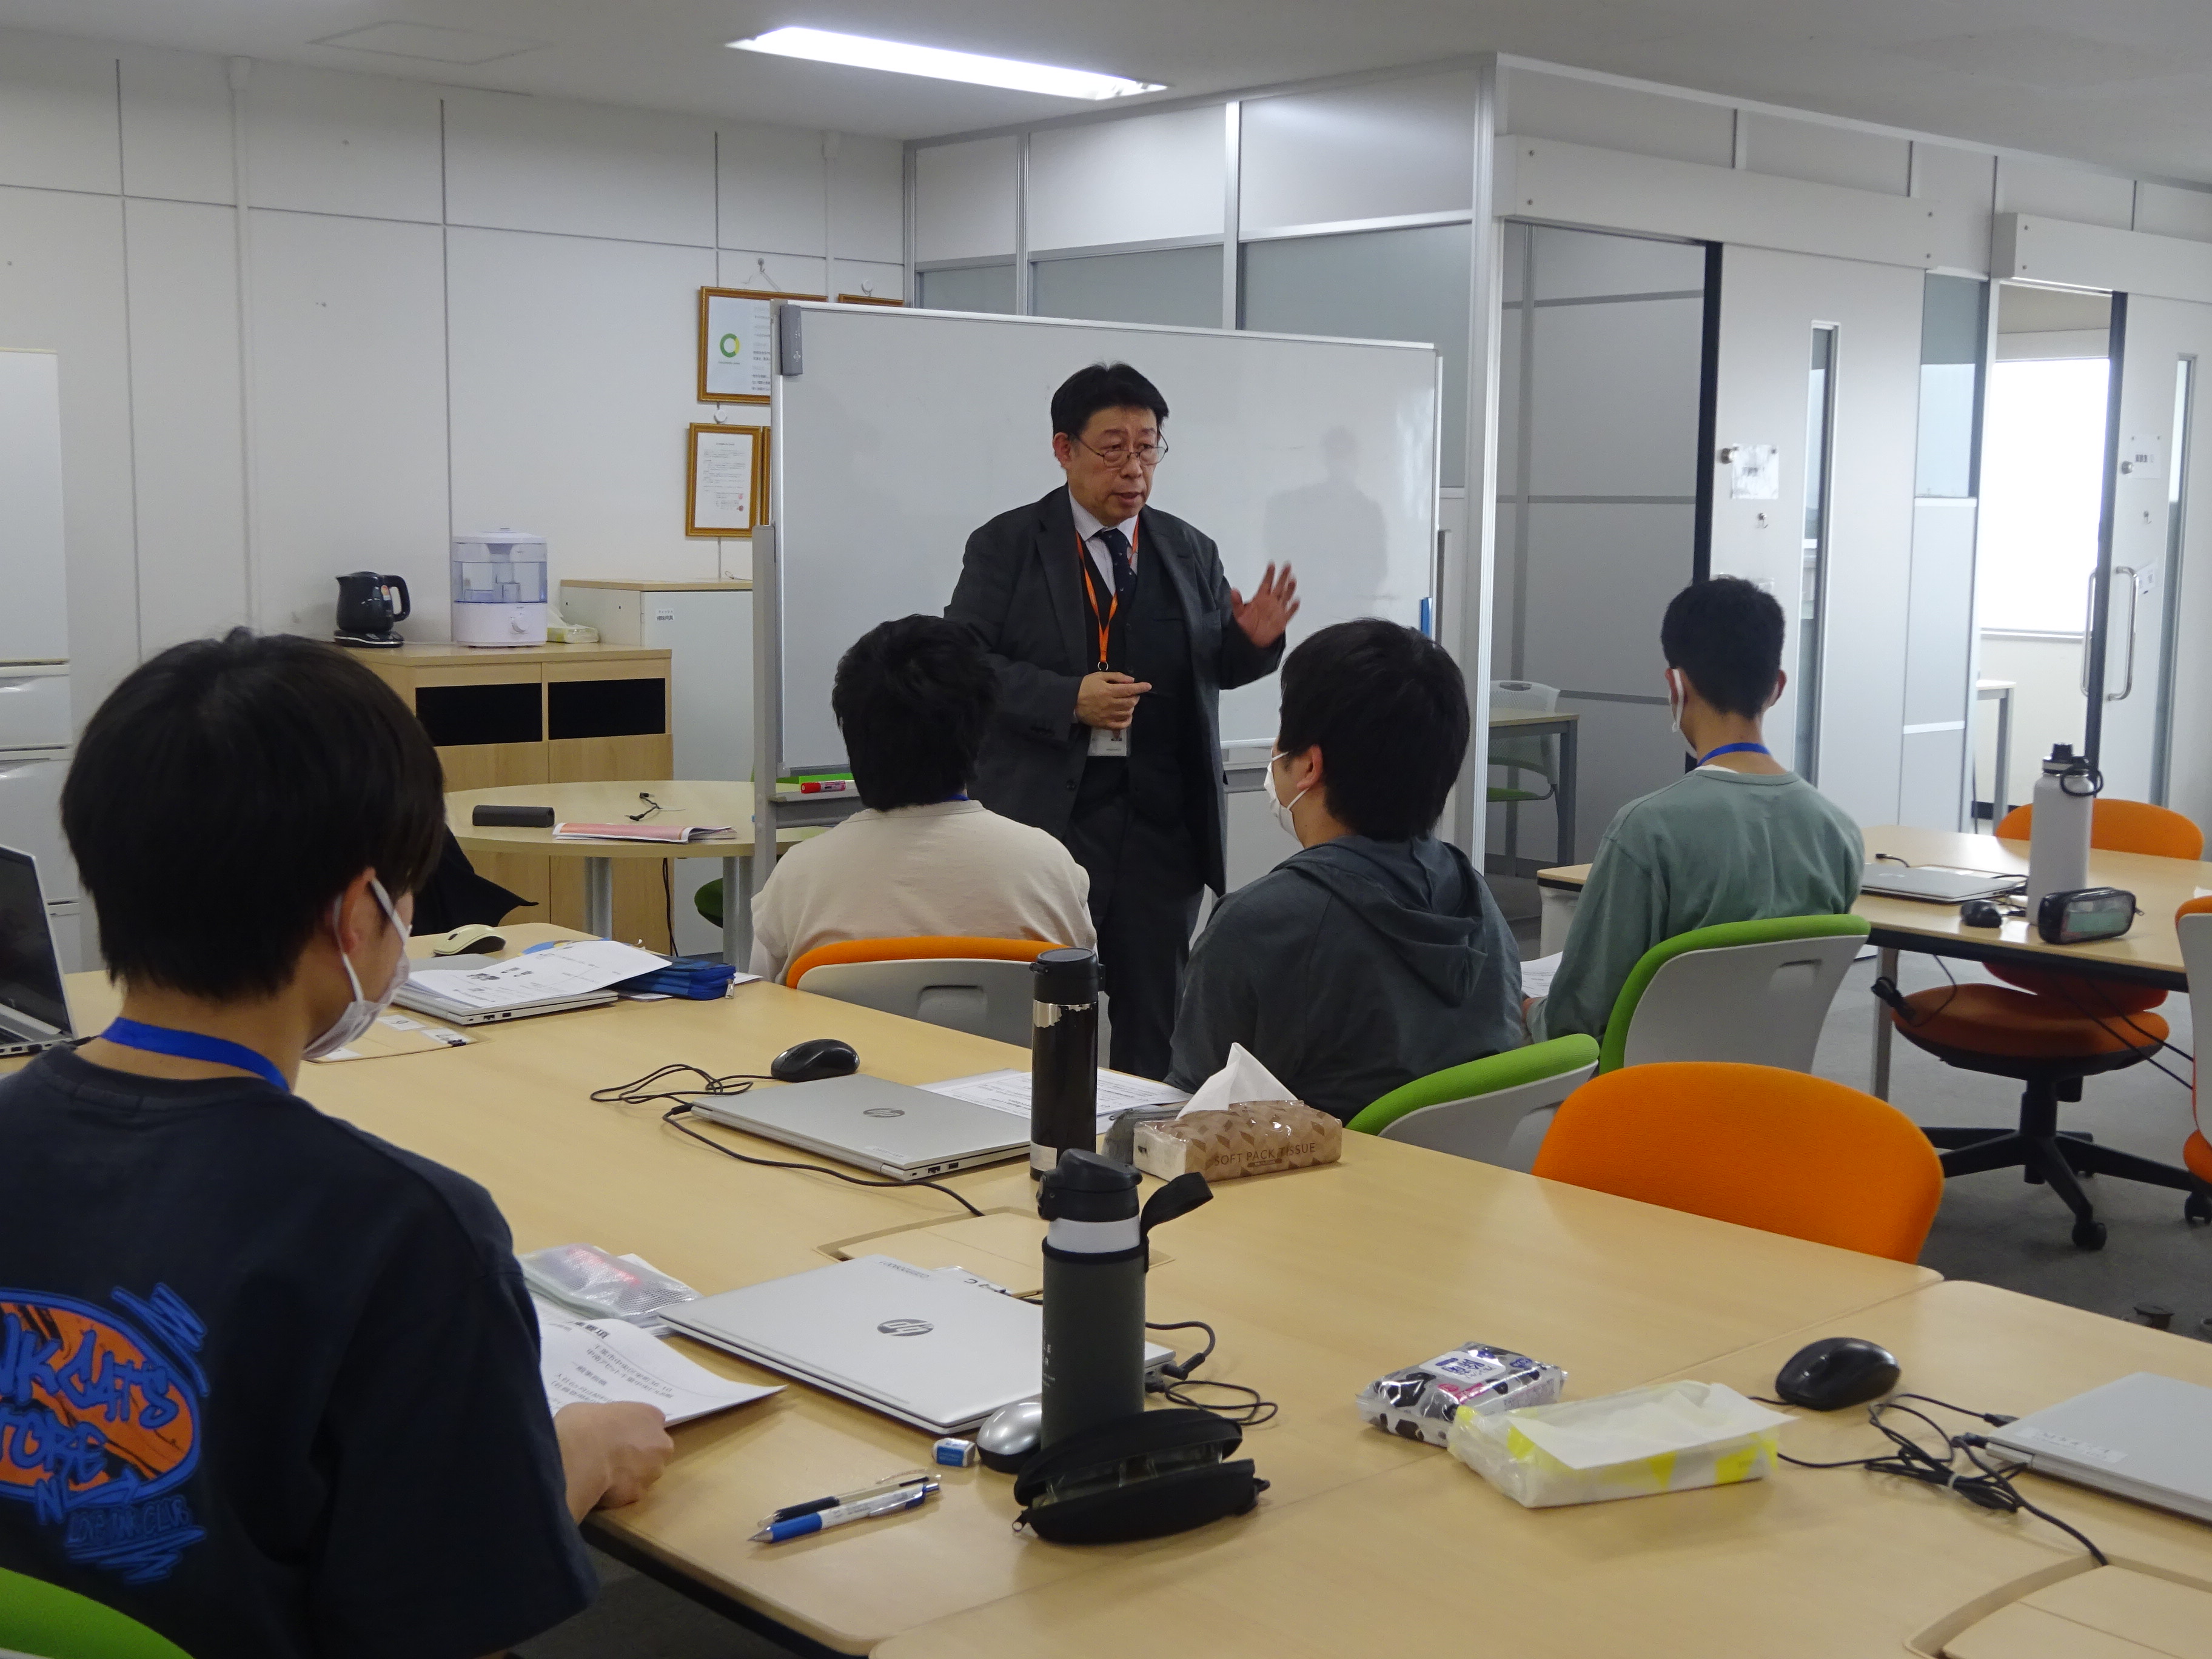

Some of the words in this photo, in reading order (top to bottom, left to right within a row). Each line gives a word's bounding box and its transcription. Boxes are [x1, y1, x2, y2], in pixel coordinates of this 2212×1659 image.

[1213, 1153, 1242, 1166] SOFT
[1246, 1149, 1275, 1161] PACK
[1278, 1142, 1316, 1156] TISSUE
